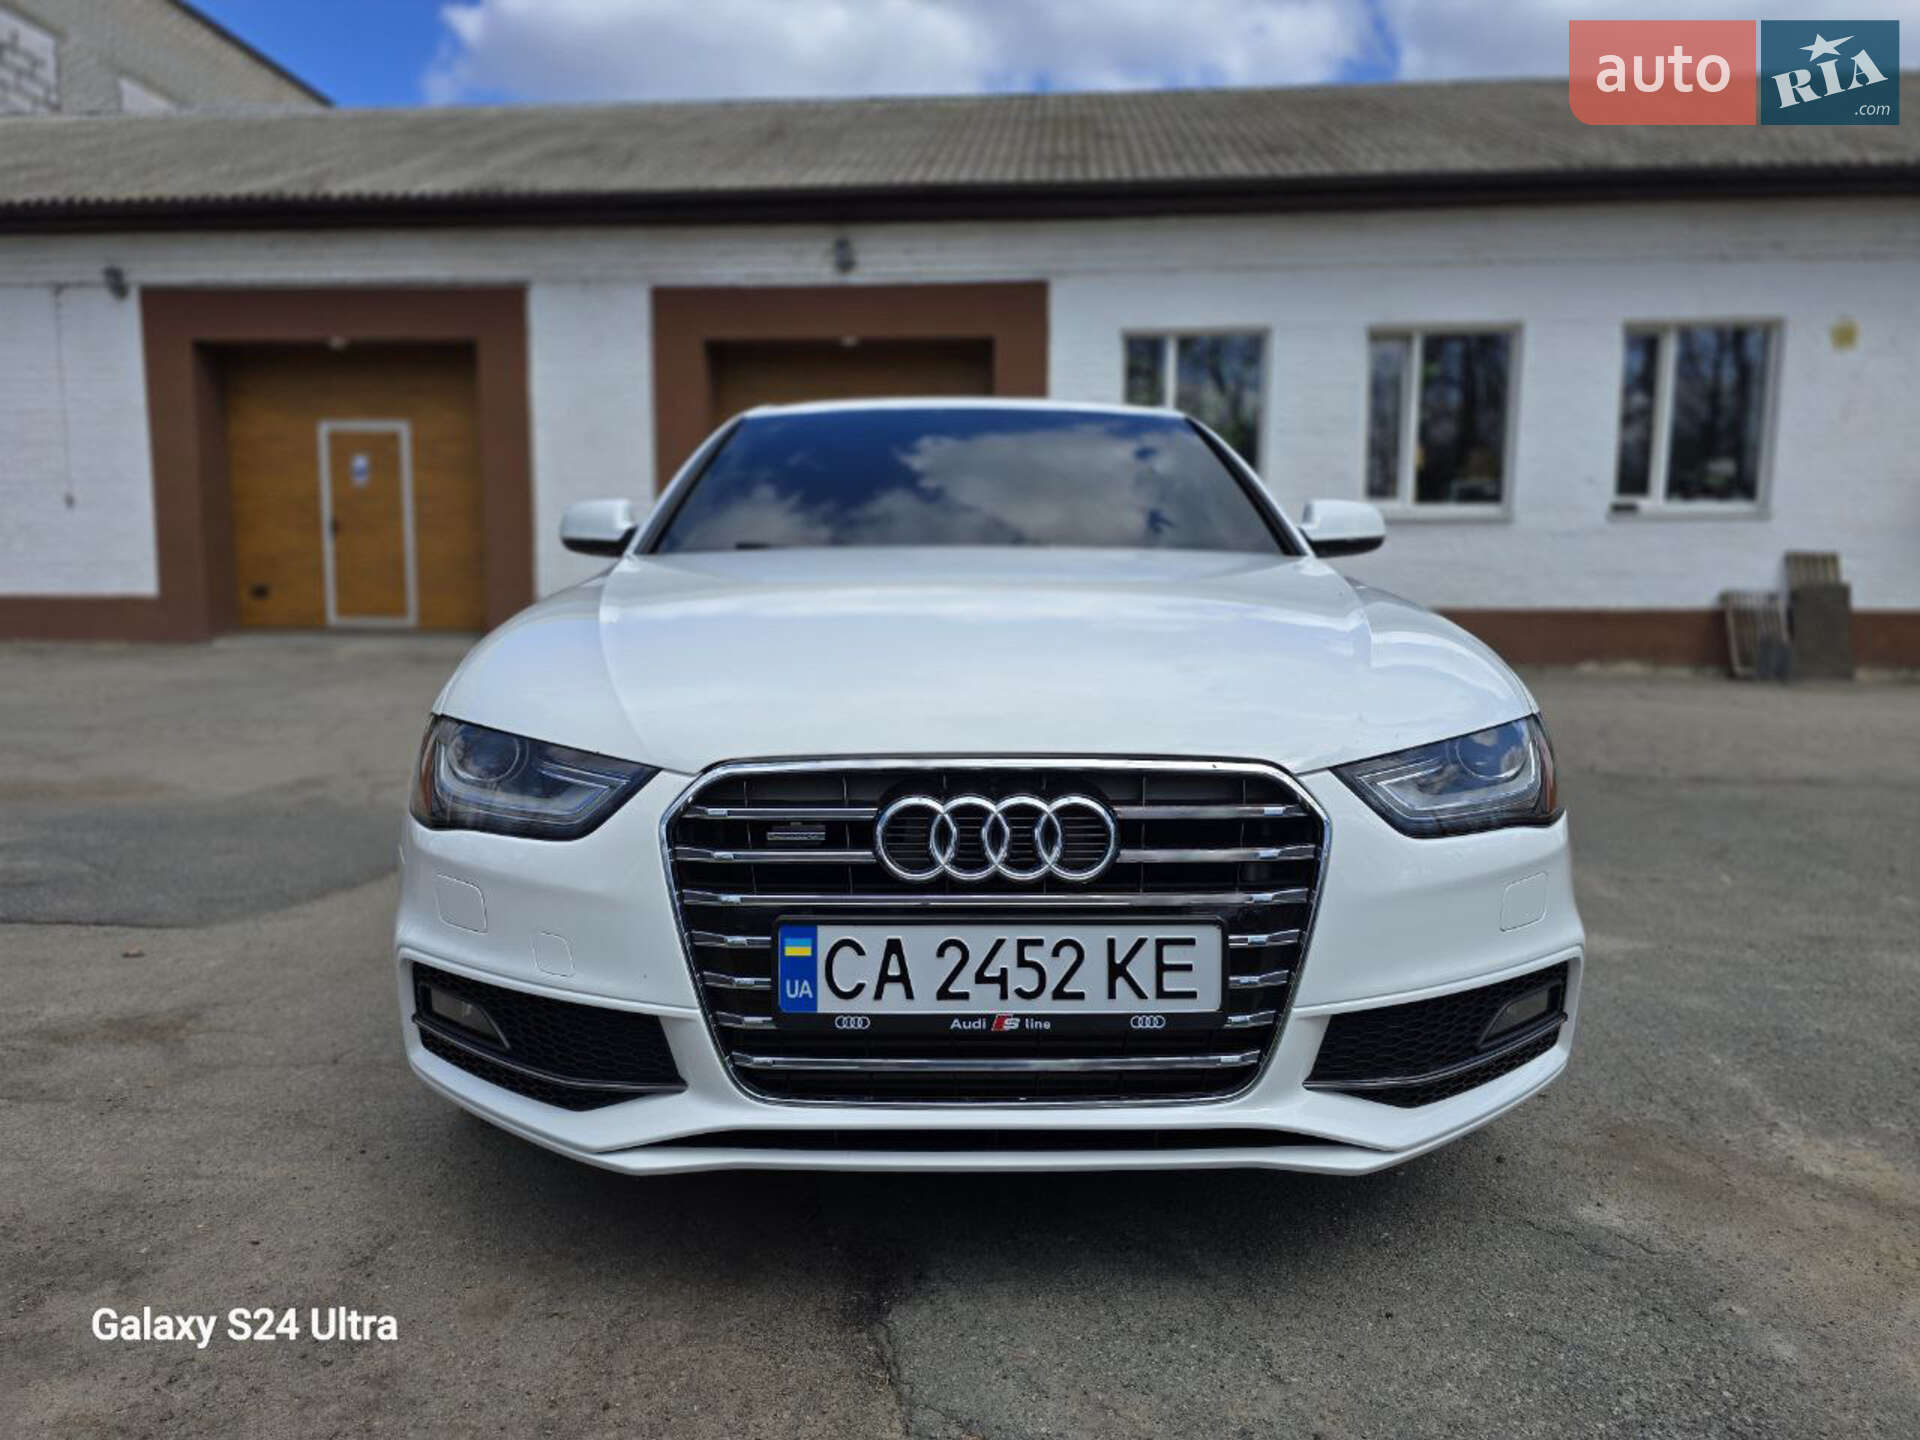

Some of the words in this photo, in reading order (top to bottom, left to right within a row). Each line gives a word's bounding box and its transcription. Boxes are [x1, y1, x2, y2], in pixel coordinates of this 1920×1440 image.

[824, 937, 914, 1001] CA
[935, 937, 1085, 1001] 2452
[1106, 937, 1198, 1001] KE
[785, 980, 813, 999] UA
[950, 1018, 986, 1031] Audi
[1025, 1018, 1051, 1031] line
